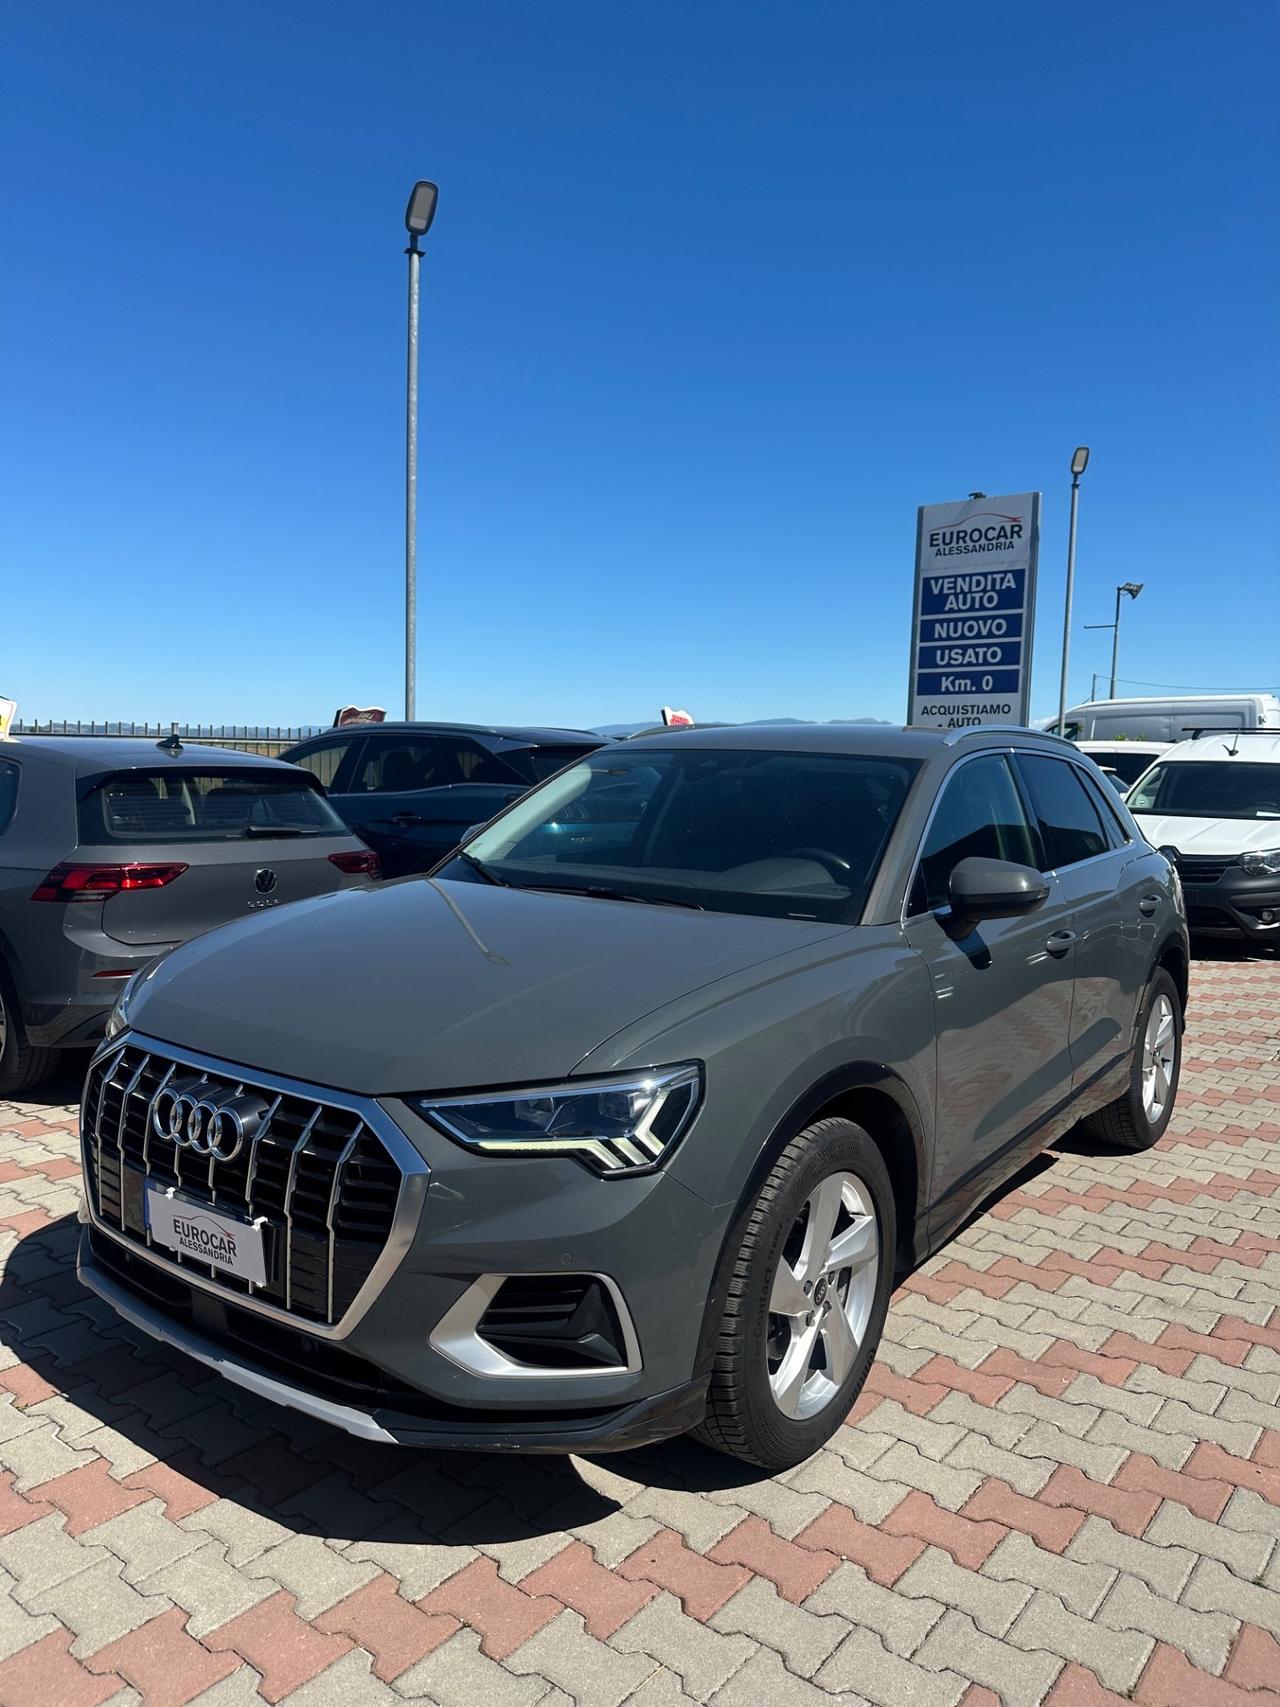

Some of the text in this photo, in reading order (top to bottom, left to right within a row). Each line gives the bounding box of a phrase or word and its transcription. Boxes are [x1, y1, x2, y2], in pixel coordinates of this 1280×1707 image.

[929, 524, 1023, 547] EUROCAR
[935, 541, 1015, 557] ALESSANDRIA
[930, 573, 1017, 595] VENDITA
[944, 591, 999, 611] AUTO
[934, 618, 1007, 639] NUOVO
[936, 646, 1002, 665] USATO
[941, 675, 993, 692] Km. 0
[921, 704, 1012, 716] ACQUISTIAMO
[947, 717, 982, 728] AUTO
[173, 1218, 237, 1257] EUROCAR
[180, 1237, 234, 1266] ALESSANDRIA
